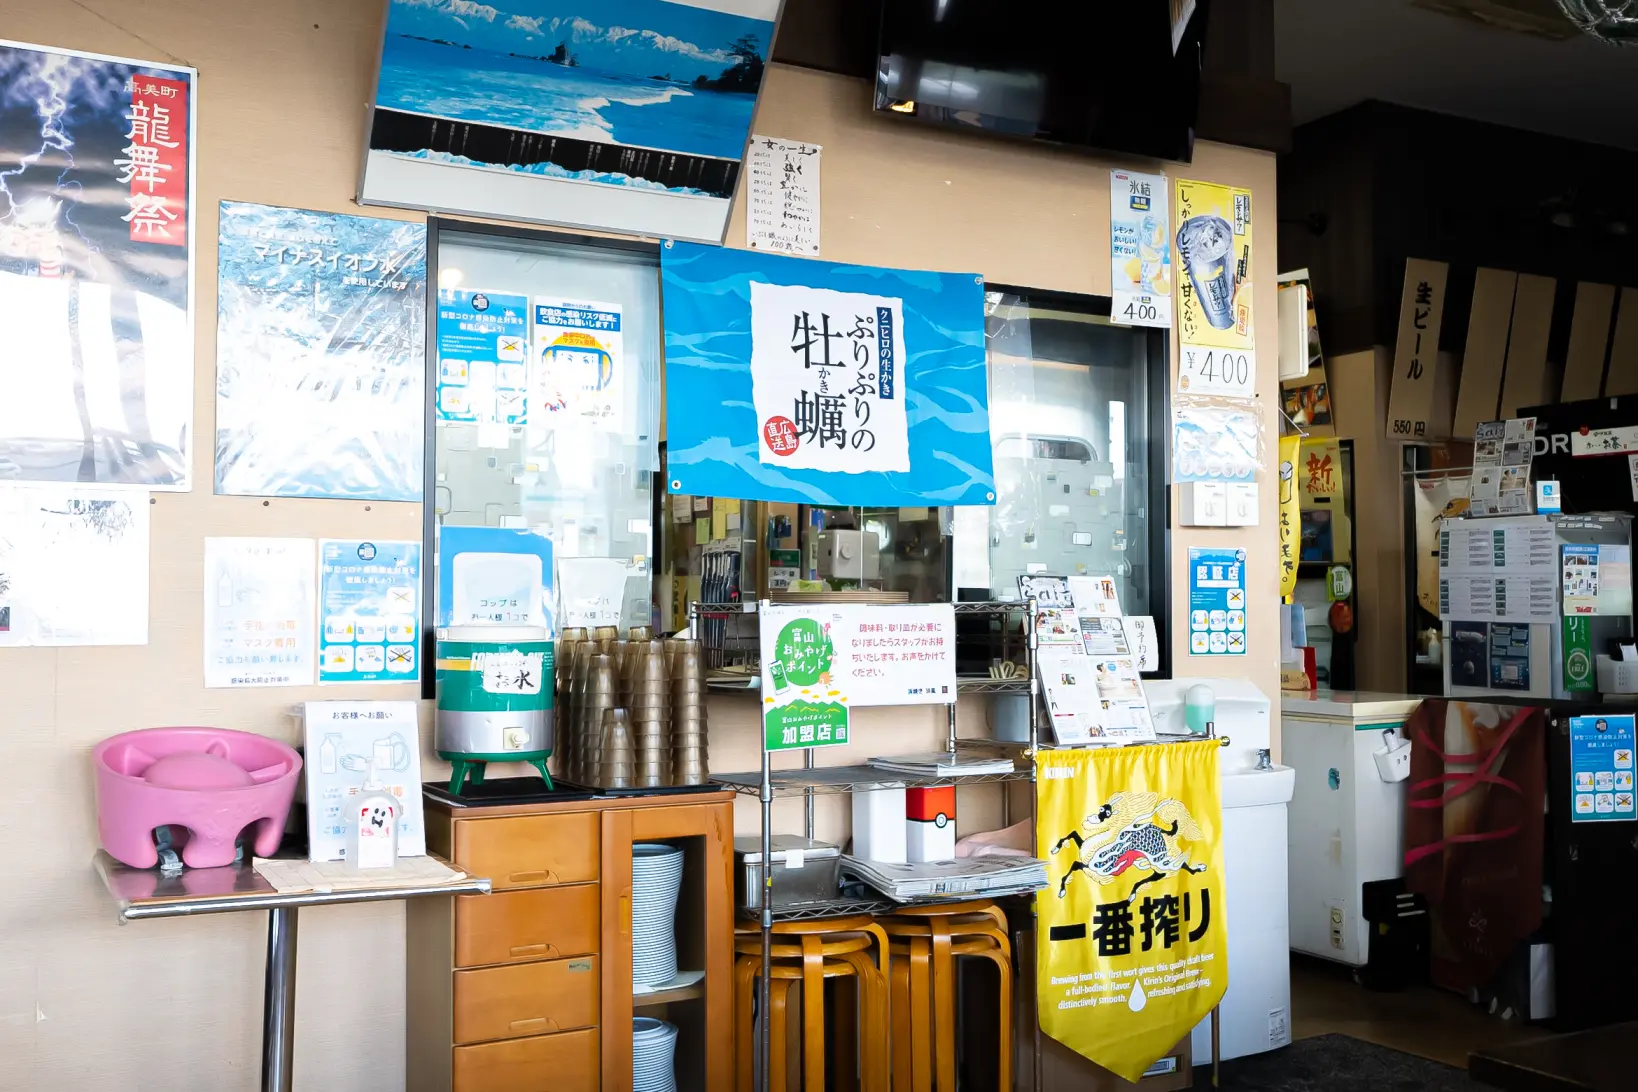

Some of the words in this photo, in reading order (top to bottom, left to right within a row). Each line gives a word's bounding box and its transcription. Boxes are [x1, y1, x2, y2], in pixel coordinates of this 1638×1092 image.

[762, 139, 816, 155] 女の一生
[113, 100, 180, 238] 龍舞祭
[1130, 180, 1152, 197] 氷結
[1114, 226, 1134, 235] レモンが
[1123, 302, 1156, 320] 400
[1407, 281, 1434, 380] 生ビール
[880, 308, 893, 397] クニヒロの生かき
[790, 310, 847, 450] 牡蠣
[818, 366, 831, 394] かき
[846, 314, 876, 453] ぷりぷりの
[1392, 419, 1411, 433] 550
[1413, 420, 1426, 436] 円
[1306, 452, 1334, 485] 新
[480, 599, 517, 608] コップは
[791, 627, 815, 644] 富山
[859, 623, 942, 633] 調味料・取り皿が必要に
[851, 636, 945, 648] なりましたらスタッフがお持
[783, 643, 828, 660] おみやげ
[785, 657, 825, 675] ポイント
[851, 667, 885, 677] ください。
[332, 710, 394, 720] お客様へお願い
[781, 723, 832, 745] 加盟店
[1049, 888, 1211, 957] 一番搾り
[1051, 974, 1078, 985] Brewing
[1079, 971, 1092, 982] from
[1094, 970, 1105, 979] the
[1123, 968, 1137, 977] wort
[1138, 965, 1154, 976] gives
[1156, 963, 1168, 972] this
[1169, 959, 1187, 971] quality
[1187, 955, 1200, 965] draft
[1200, 953, 1214, 962] beer
[1143, 975, 1163, 986] Kirin's
[1164, 971, 1185, 984] Original
[1071, 982, 1108, 996] full-bodied
[1147, 986, 1176, 998] refreshing
[1176, 984, 1185, 993] and
[1185, 978, 1212, 991] satisfying.
[1058, 996, 1098, 1010] distinctively
[1098, 994, 1127, 1004] smooth.
